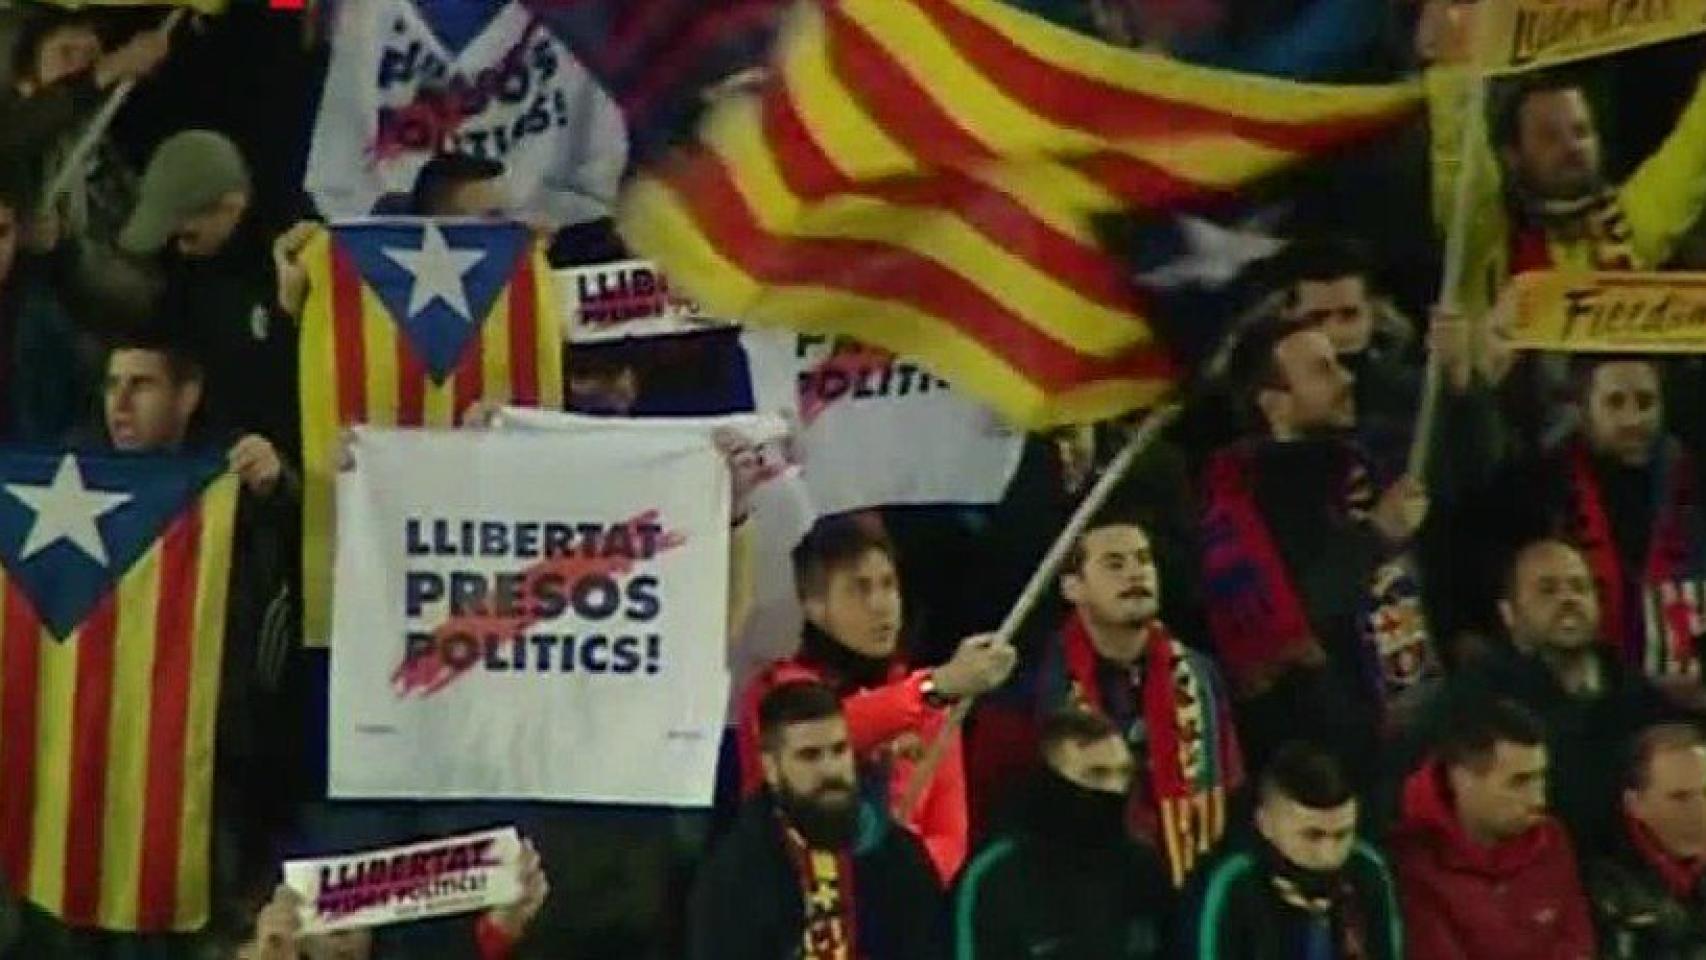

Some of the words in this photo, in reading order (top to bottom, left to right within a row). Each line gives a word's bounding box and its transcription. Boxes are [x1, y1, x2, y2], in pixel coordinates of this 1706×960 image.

[405, 518, 662, 560] LLIBERTAT
[405, 571, 661, 621] PRESOS
[405, 632, 661, 675] POLITICS!
[320, 838, 497, 894] LLIBERTAT
